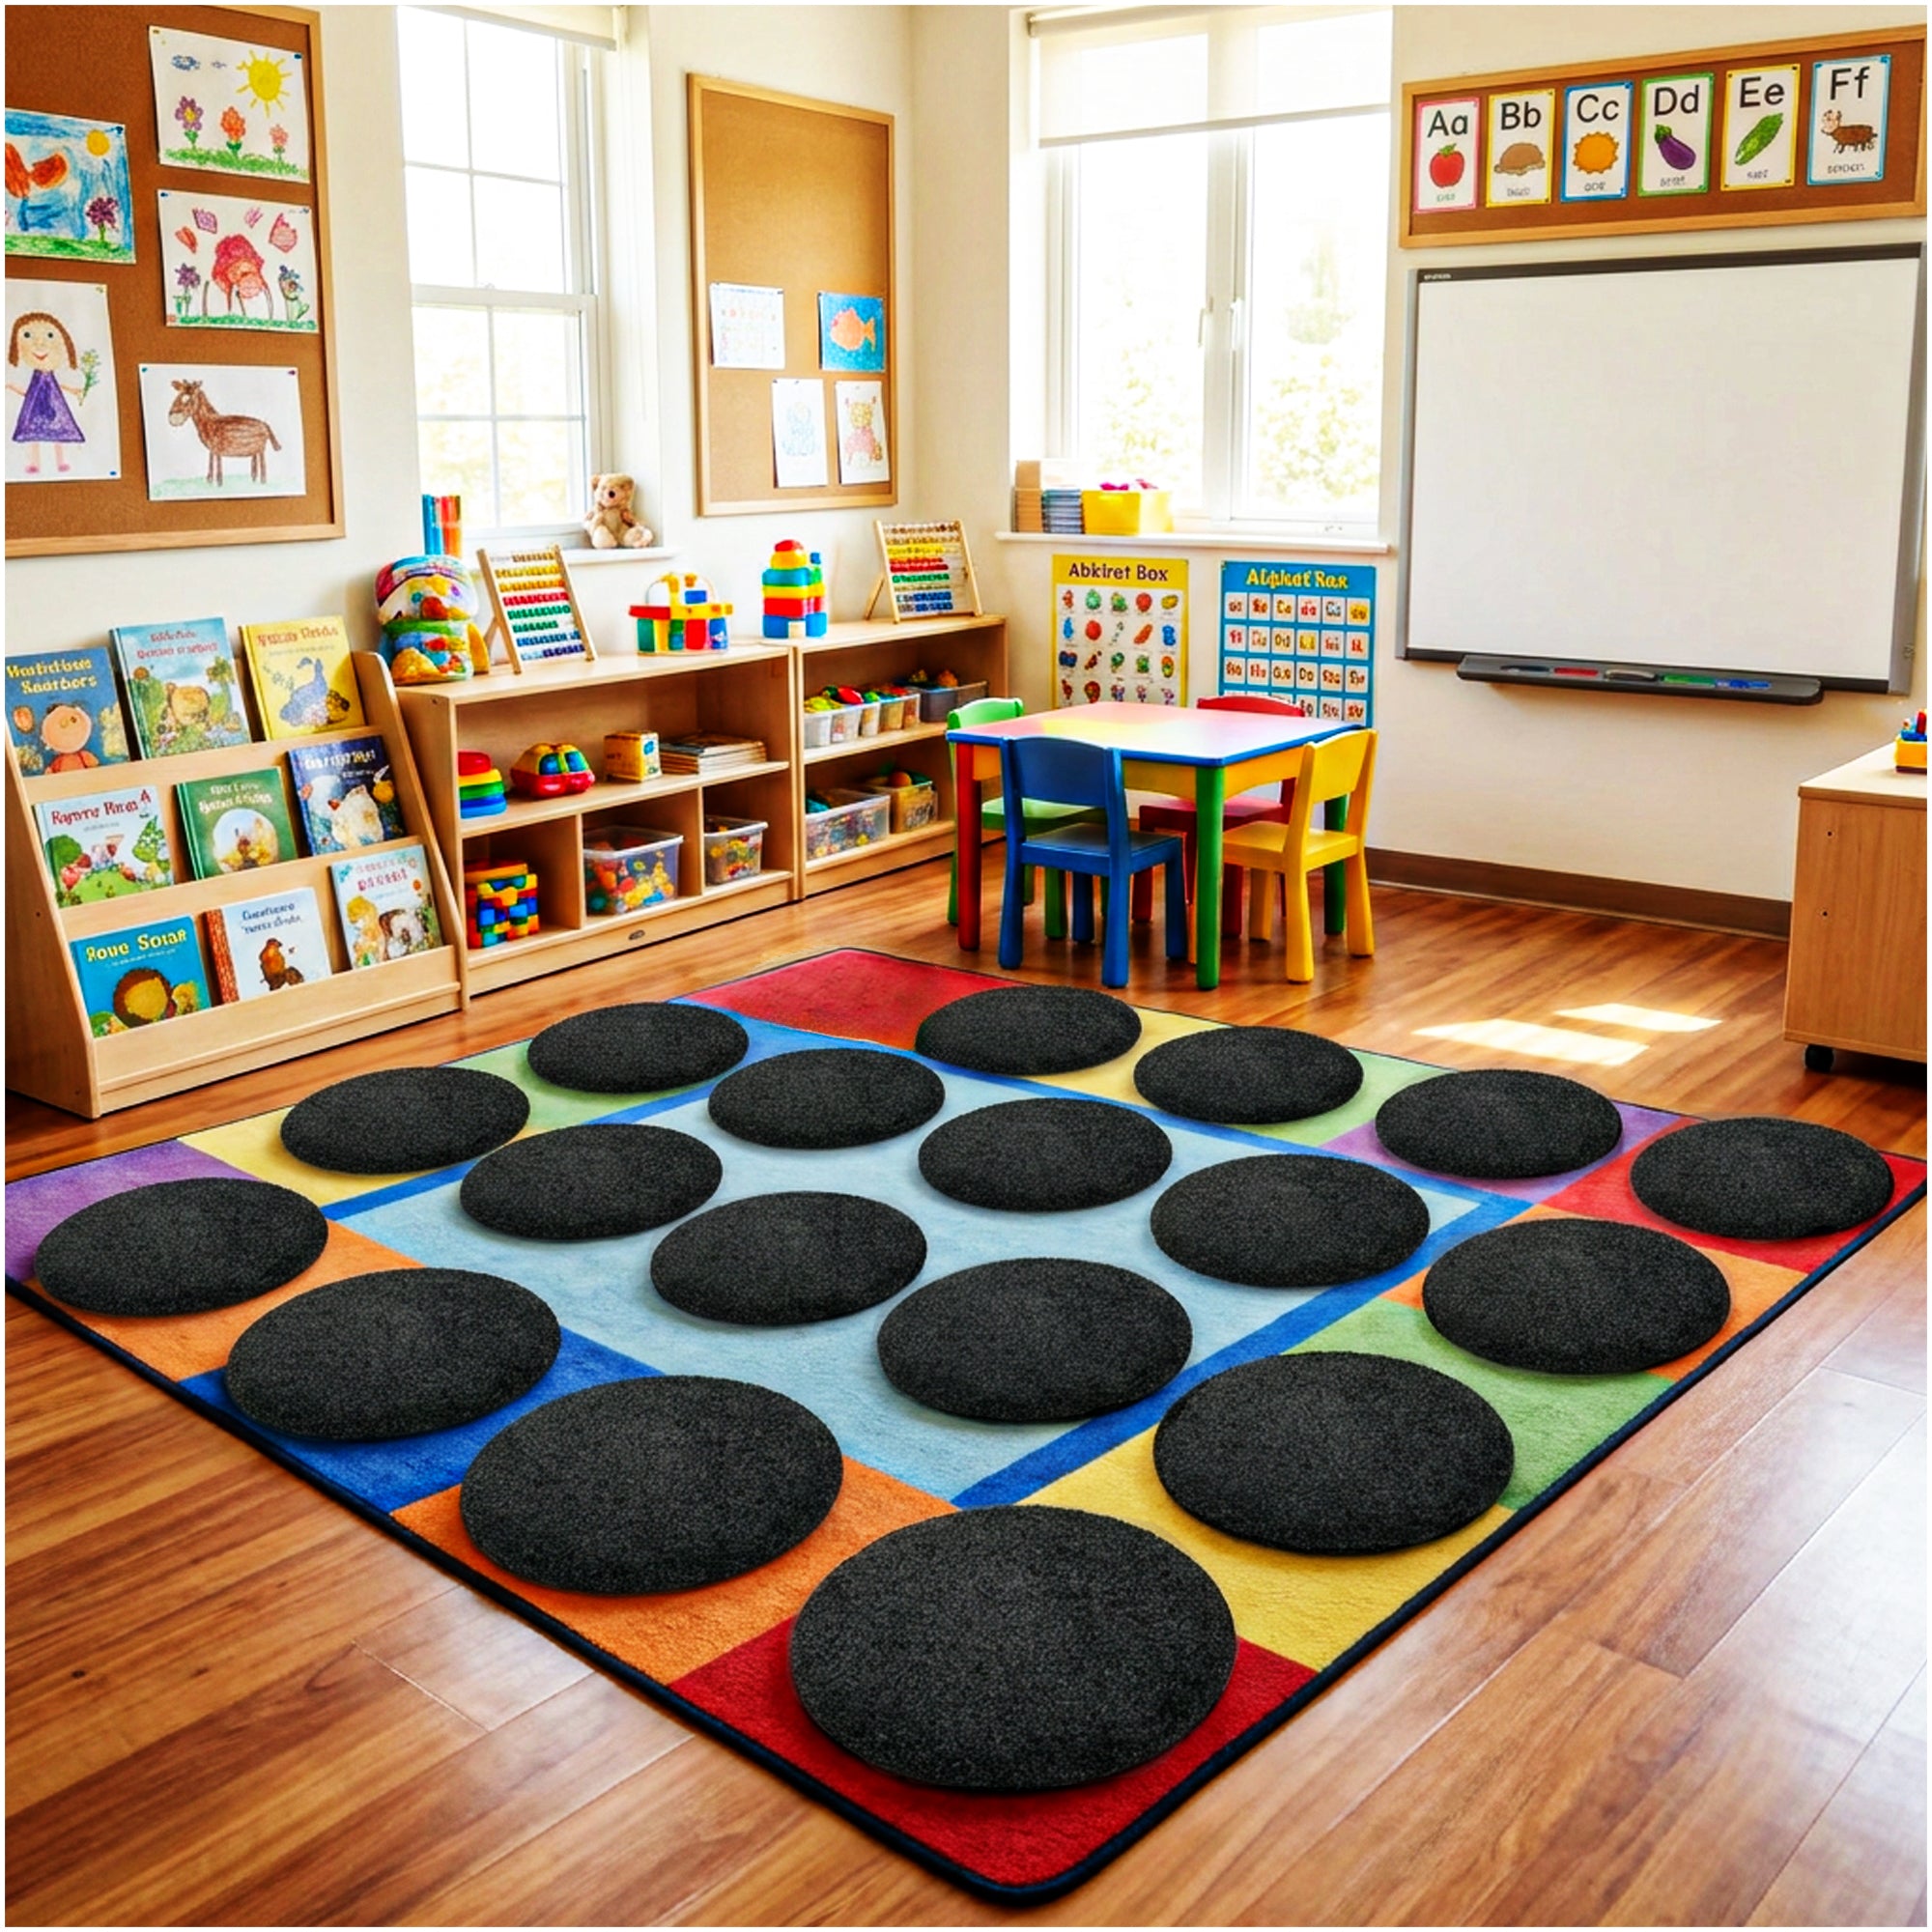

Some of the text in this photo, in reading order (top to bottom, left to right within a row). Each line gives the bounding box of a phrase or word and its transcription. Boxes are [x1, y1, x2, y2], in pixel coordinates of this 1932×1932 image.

[1739, 75, 1784, 108] Ee
[1830, 66, 1870, 100] Ff
[1577, 94, 1619, 123] Cc
[1654, 84, 1699, 117] Dd
[1427, 109, 1468, 138] Aa
[1501, 101, 1542, 130] Bb
[1068, 562, 1168, 582] Abkiret Box
